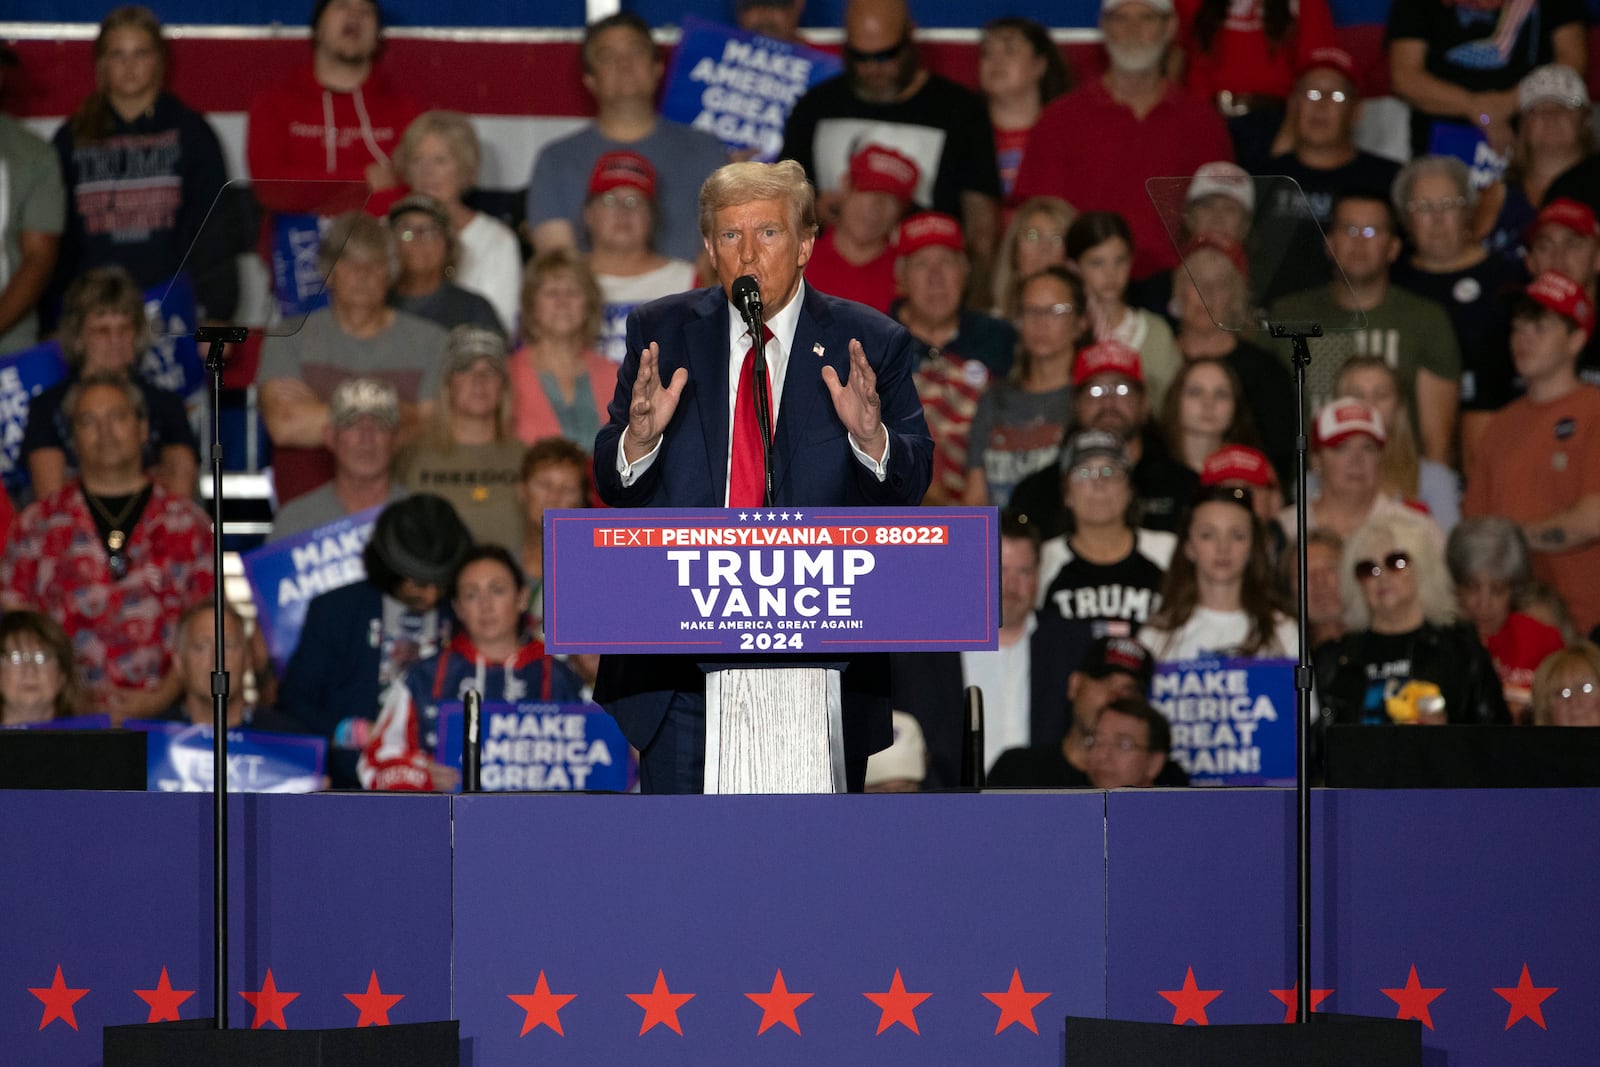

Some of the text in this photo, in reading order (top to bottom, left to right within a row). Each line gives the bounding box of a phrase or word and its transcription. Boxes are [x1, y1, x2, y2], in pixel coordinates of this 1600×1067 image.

[721, 38, 813, 86] MAKE
[689, 57, 808, 102] AMERIC
[420, 468, 521, 484] FREEDO
[599, 526, 944, 546] TEXT PENNSYLVANIA TO 88022
[278, 556, 367, 607] AMER
[666, 549, 876, 587] TRUMP
[690, 587, 852, 618] VANCE
[680, 620, 863, 630] MAKE AMERICA GREAT AGAIN!
[739, 632, 804, 650] 2024
[1153, 670, 1248, 697] MAKE
[1150, 695, 1278, 722] MERICA
[489, 713, 586, 740] MAKE
[1170, 722, 1258, 747] REAT
[460, 739, 613, 766] MERICA
[1171, 746, 1262, 775] AIN!
